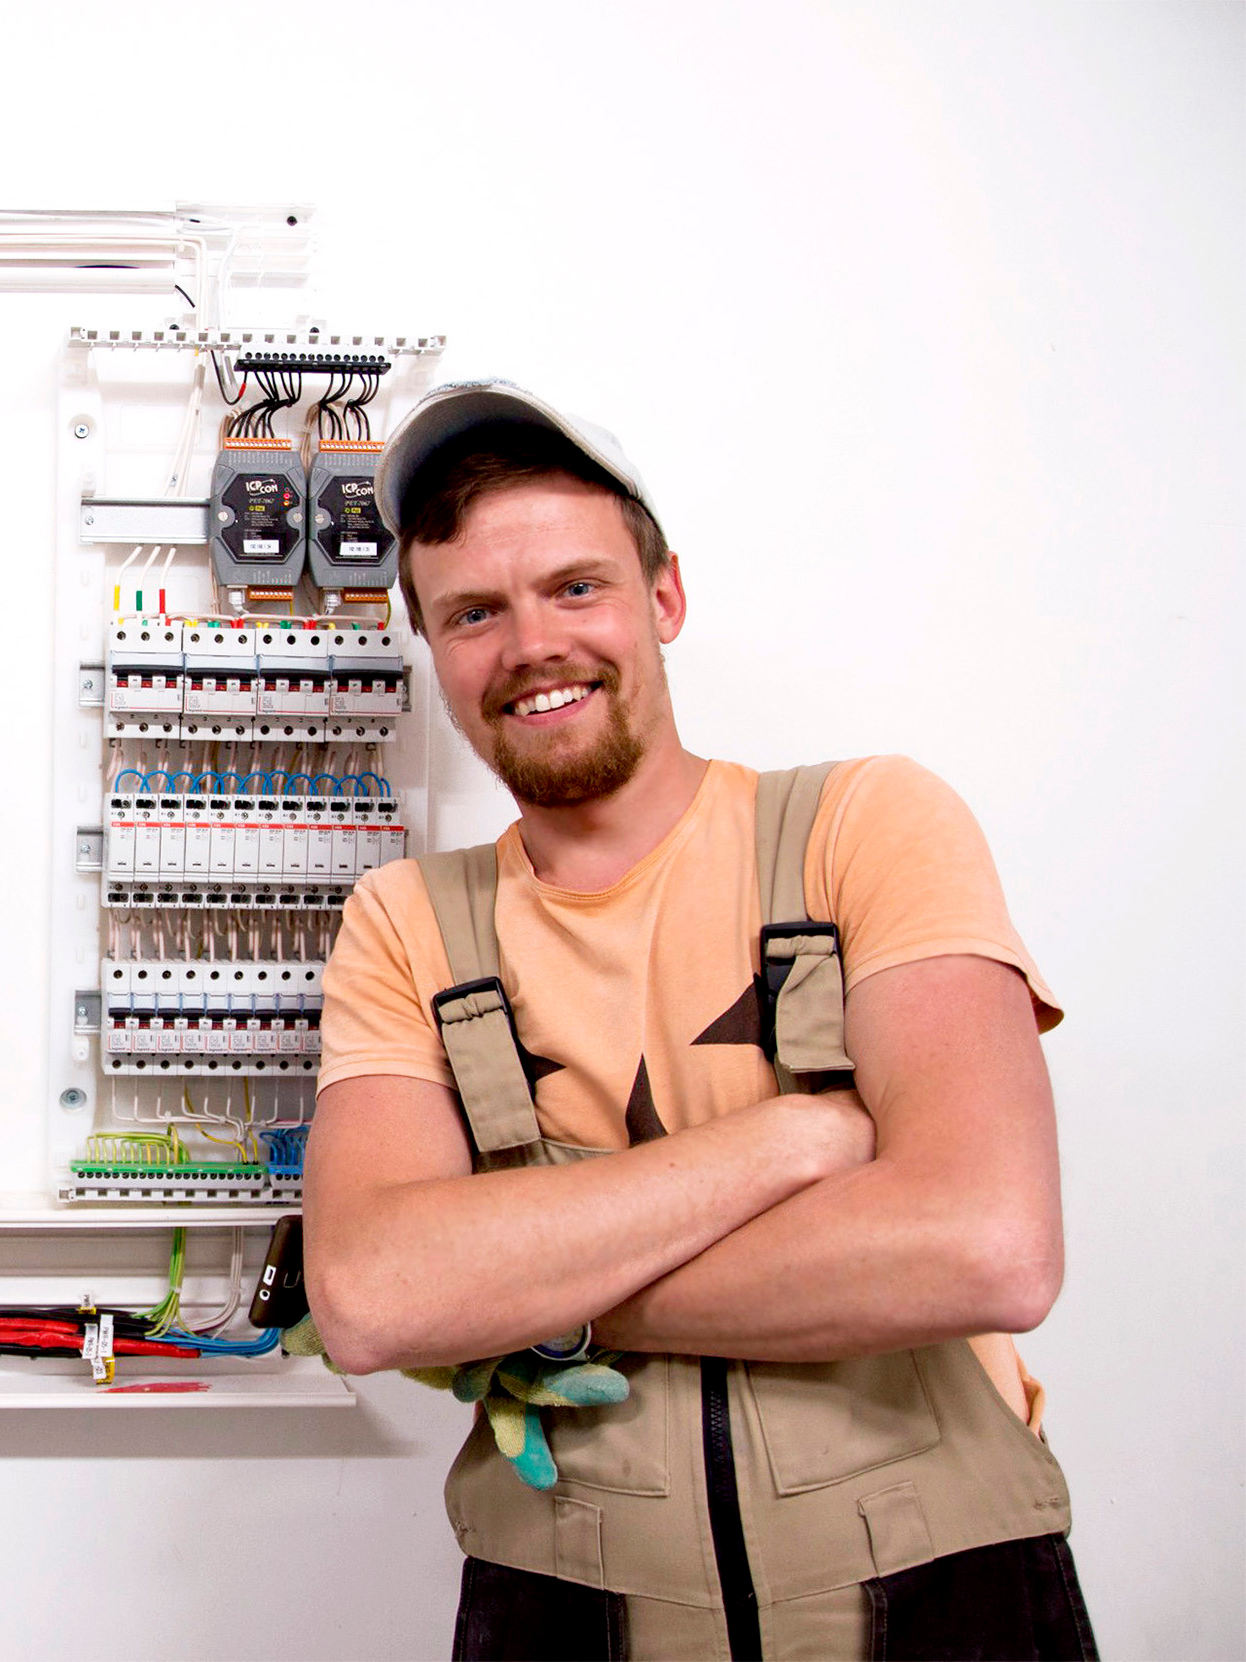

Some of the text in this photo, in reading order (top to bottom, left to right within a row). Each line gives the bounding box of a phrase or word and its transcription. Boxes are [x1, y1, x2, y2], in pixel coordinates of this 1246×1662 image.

[245, 480, 278, 493] ICP CON
[341, 483, 374, 496] ICP CON
